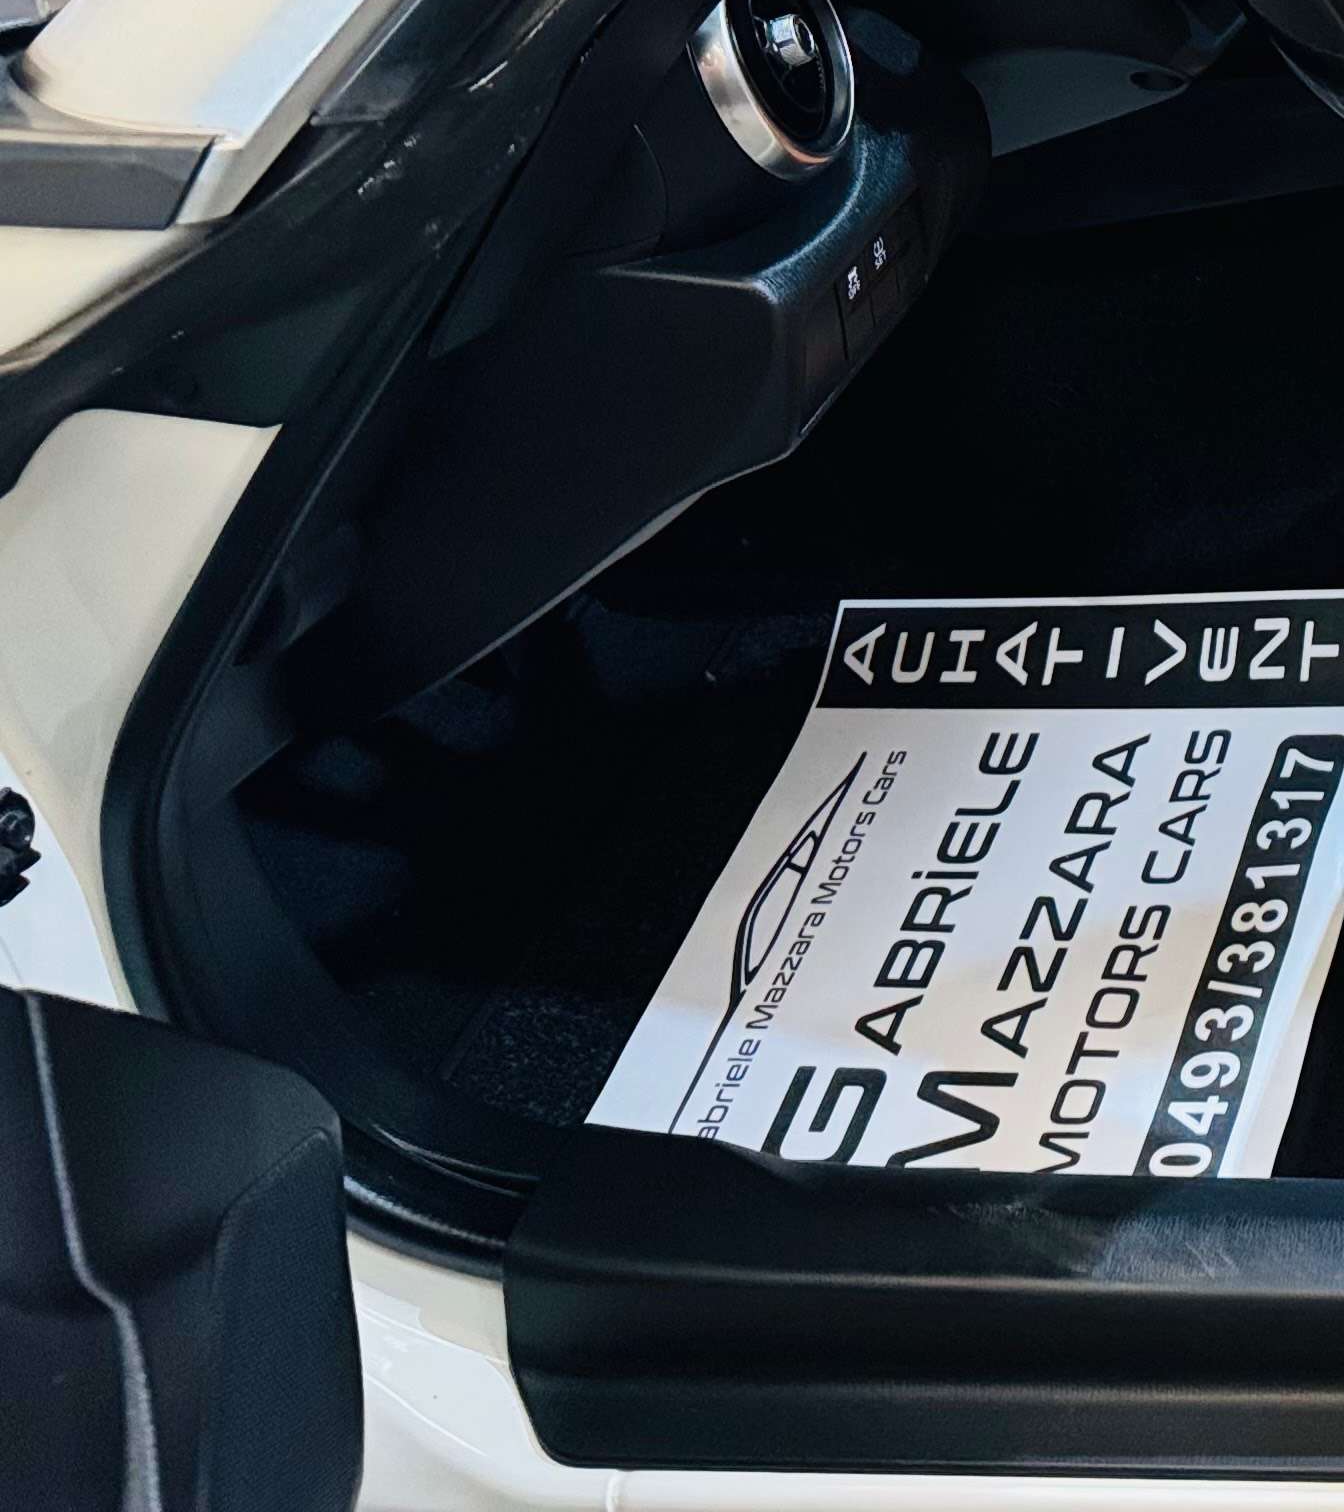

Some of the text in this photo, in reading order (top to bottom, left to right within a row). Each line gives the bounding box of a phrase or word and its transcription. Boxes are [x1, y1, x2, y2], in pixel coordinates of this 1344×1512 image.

[696, 749, 908, 1141] abriele Mazzara Motors Cars
[884, 732, 1152, 1171] MAZZARA
[1034, 728, 1232, 1174] MOTORS CARS
[1148, 747, 1335, 1178] 0493/381317
